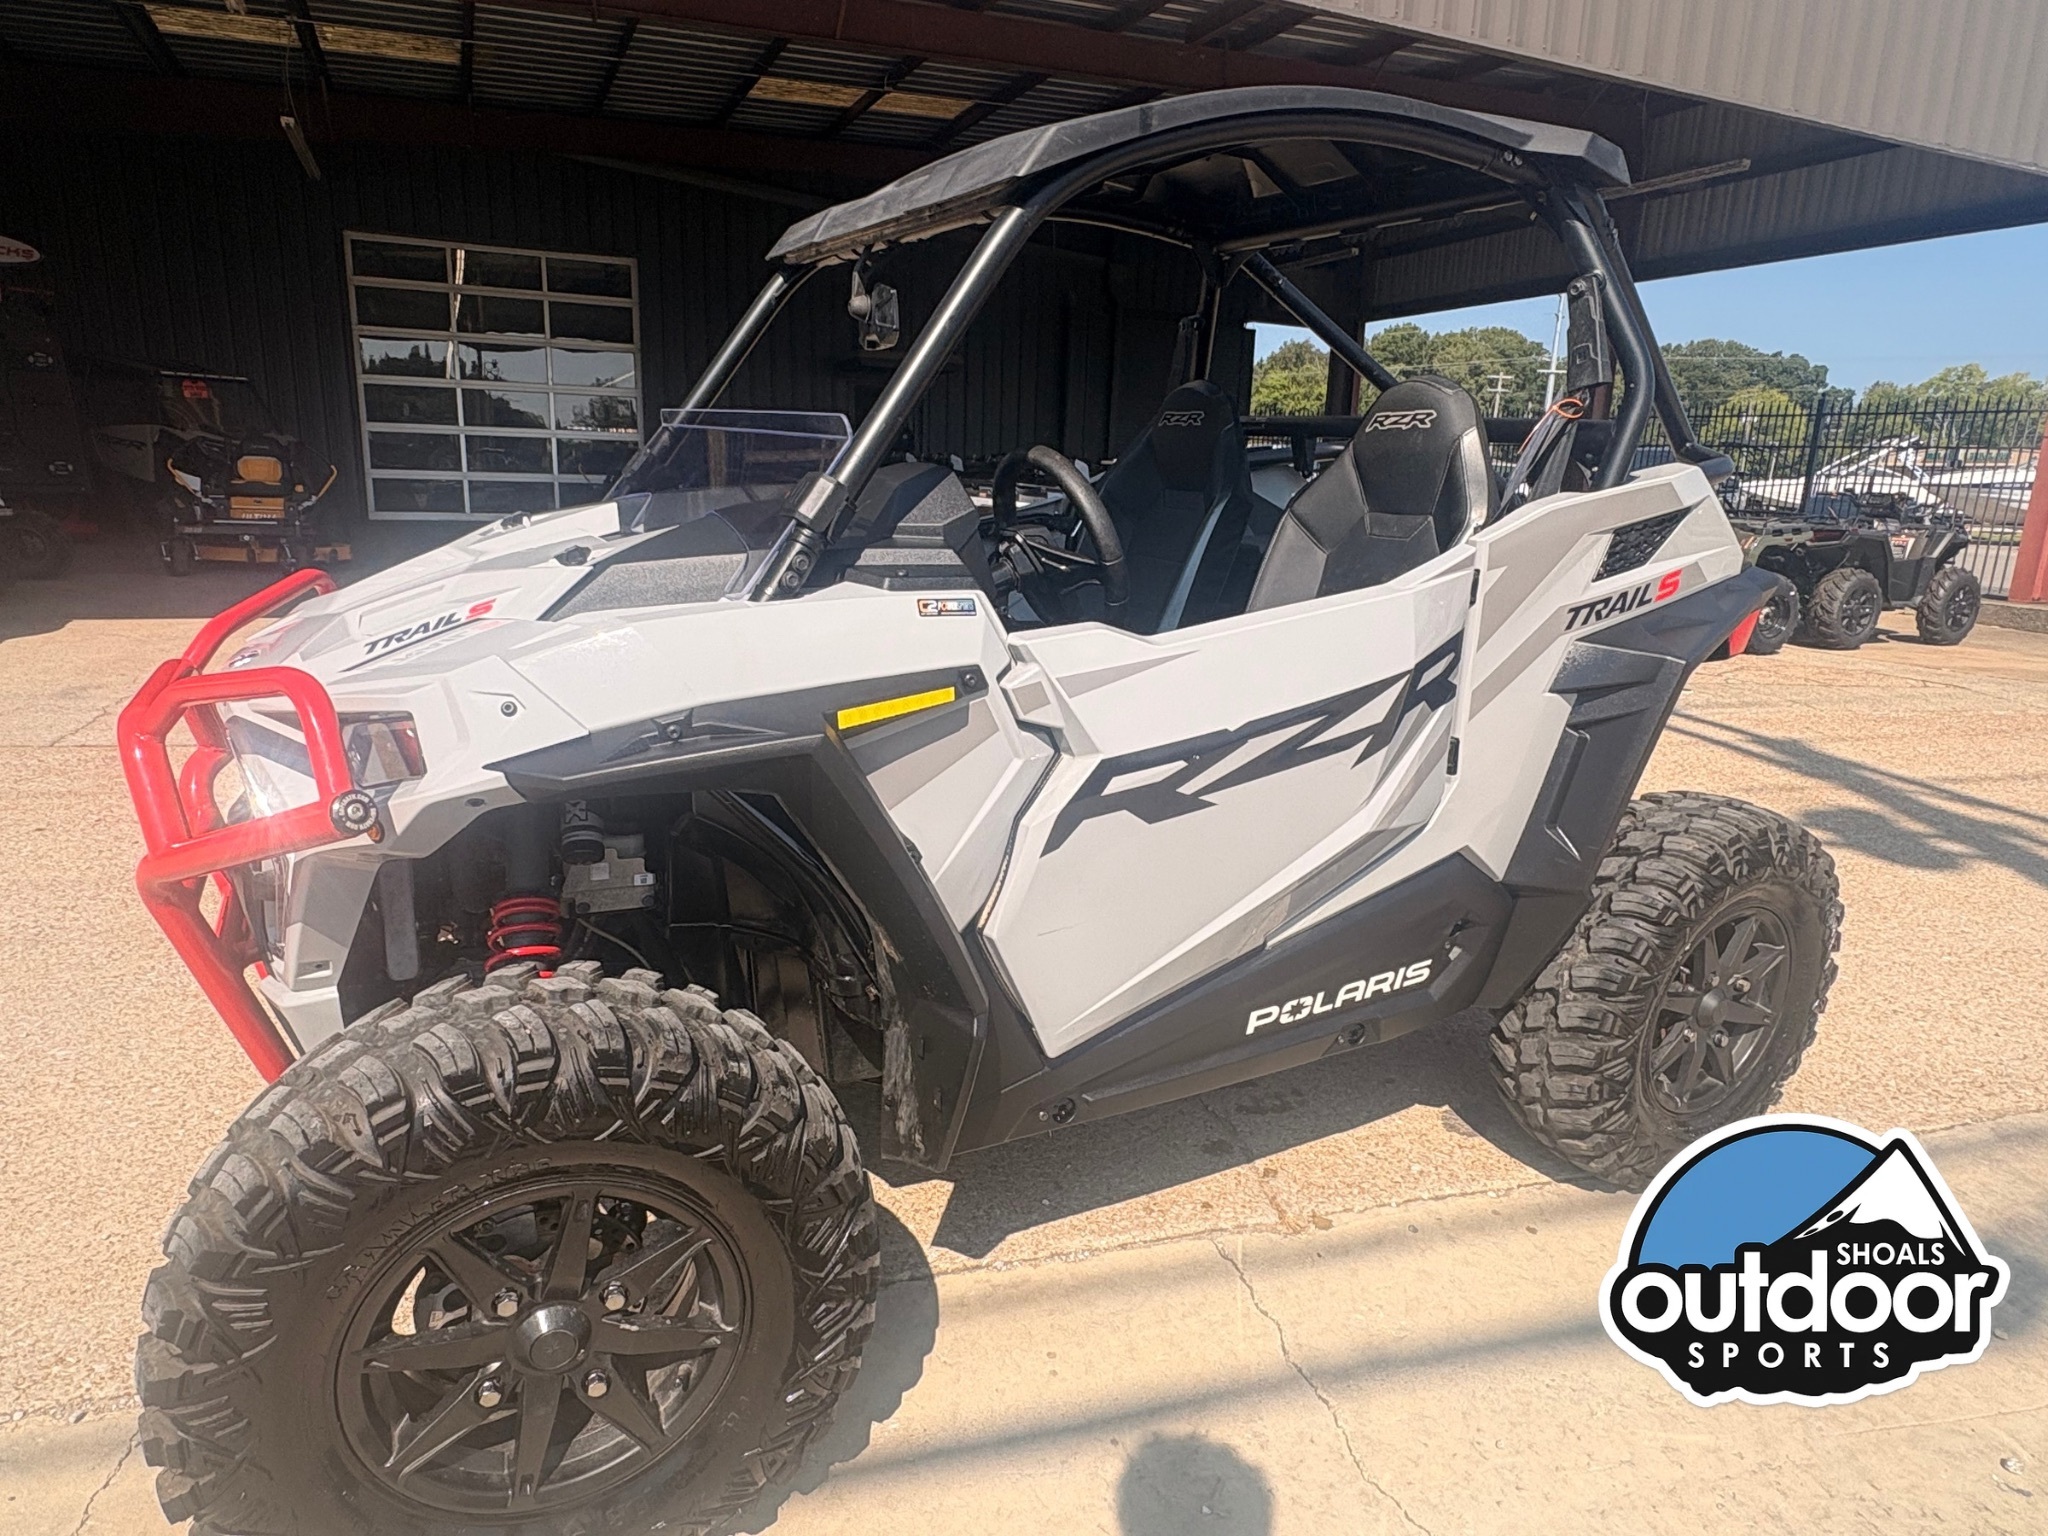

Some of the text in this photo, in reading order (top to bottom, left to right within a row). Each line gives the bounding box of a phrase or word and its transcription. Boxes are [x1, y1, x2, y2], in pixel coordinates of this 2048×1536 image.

[1158, 411, 1205, 427] RZR
[1365, 410, 1437, 433] RZR
[364, 598, 497, 655] TRAIL S
[1564, 569, 1683, 632] TRAIL S
[1040, 629, 1464, 858] RZR
[1245, 959, 1433, 1035] POLARIS
